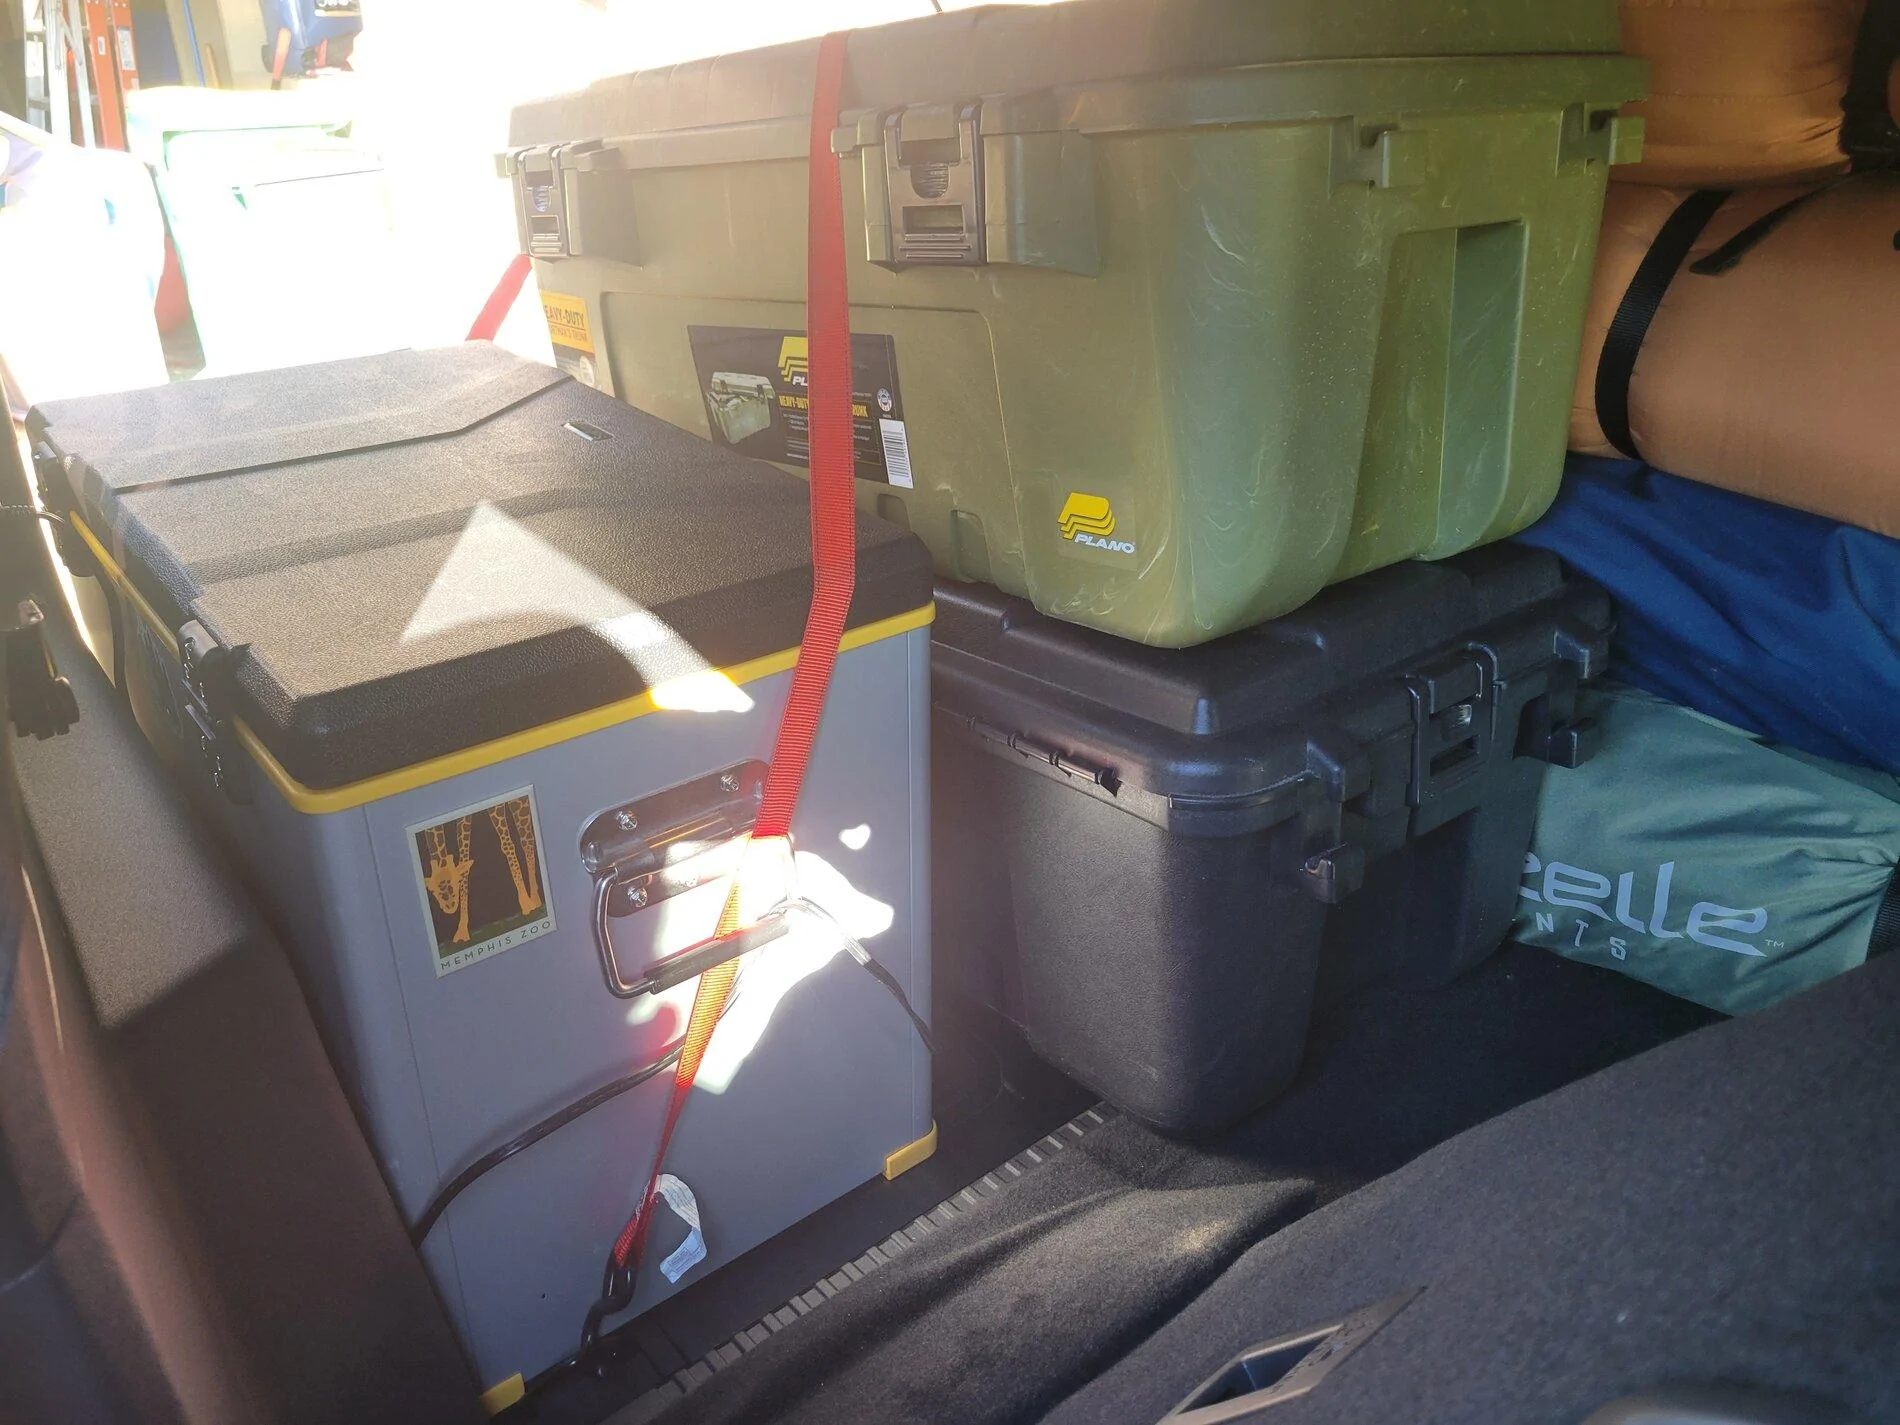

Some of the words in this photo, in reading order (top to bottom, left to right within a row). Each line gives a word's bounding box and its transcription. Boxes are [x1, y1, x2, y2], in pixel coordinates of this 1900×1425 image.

[543, 304, 585, 328] EAVY-DUTY
[851, 403, 869, 417] RUNK
[1074, 533, 1136, 554] PLANO
[441, 936, 512, 970] MEMPHIS
[521, 921, 551, 939] ZOO
[1535, 911, 1628, 961] NTS
